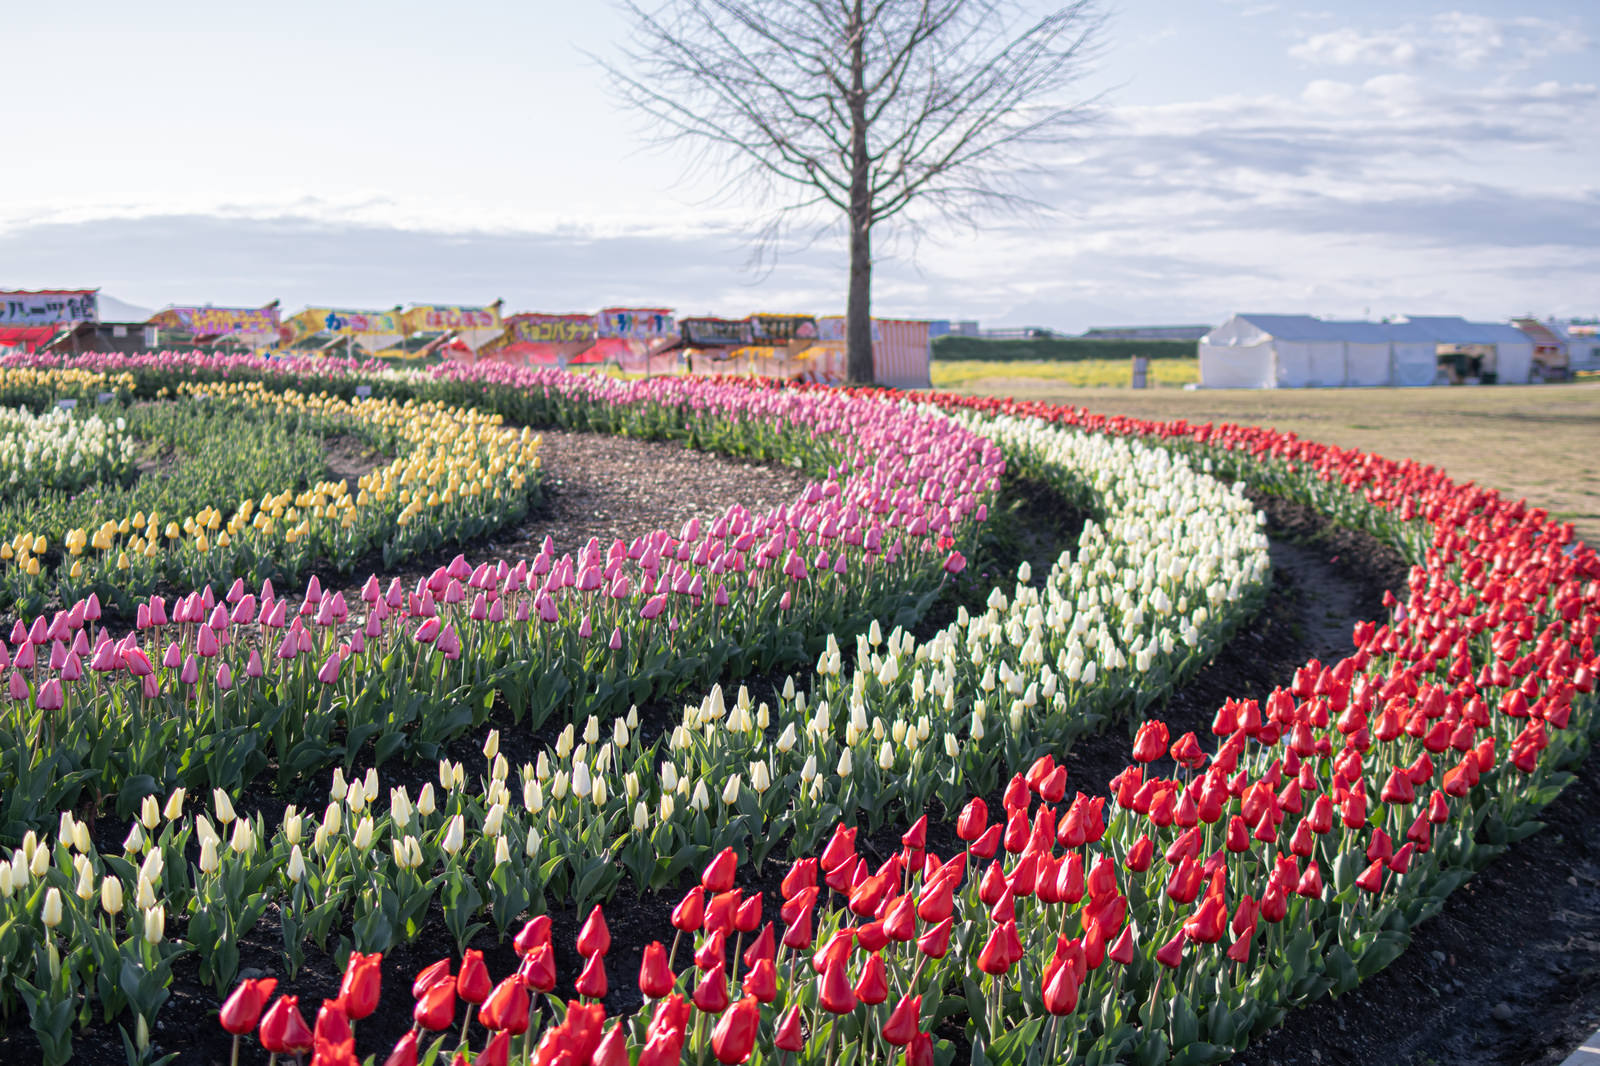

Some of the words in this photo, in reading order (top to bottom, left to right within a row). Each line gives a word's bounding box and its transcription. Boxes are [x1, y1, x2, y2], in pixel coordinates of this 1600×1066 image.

[519, 320, 592, 341] チョコバナナ
